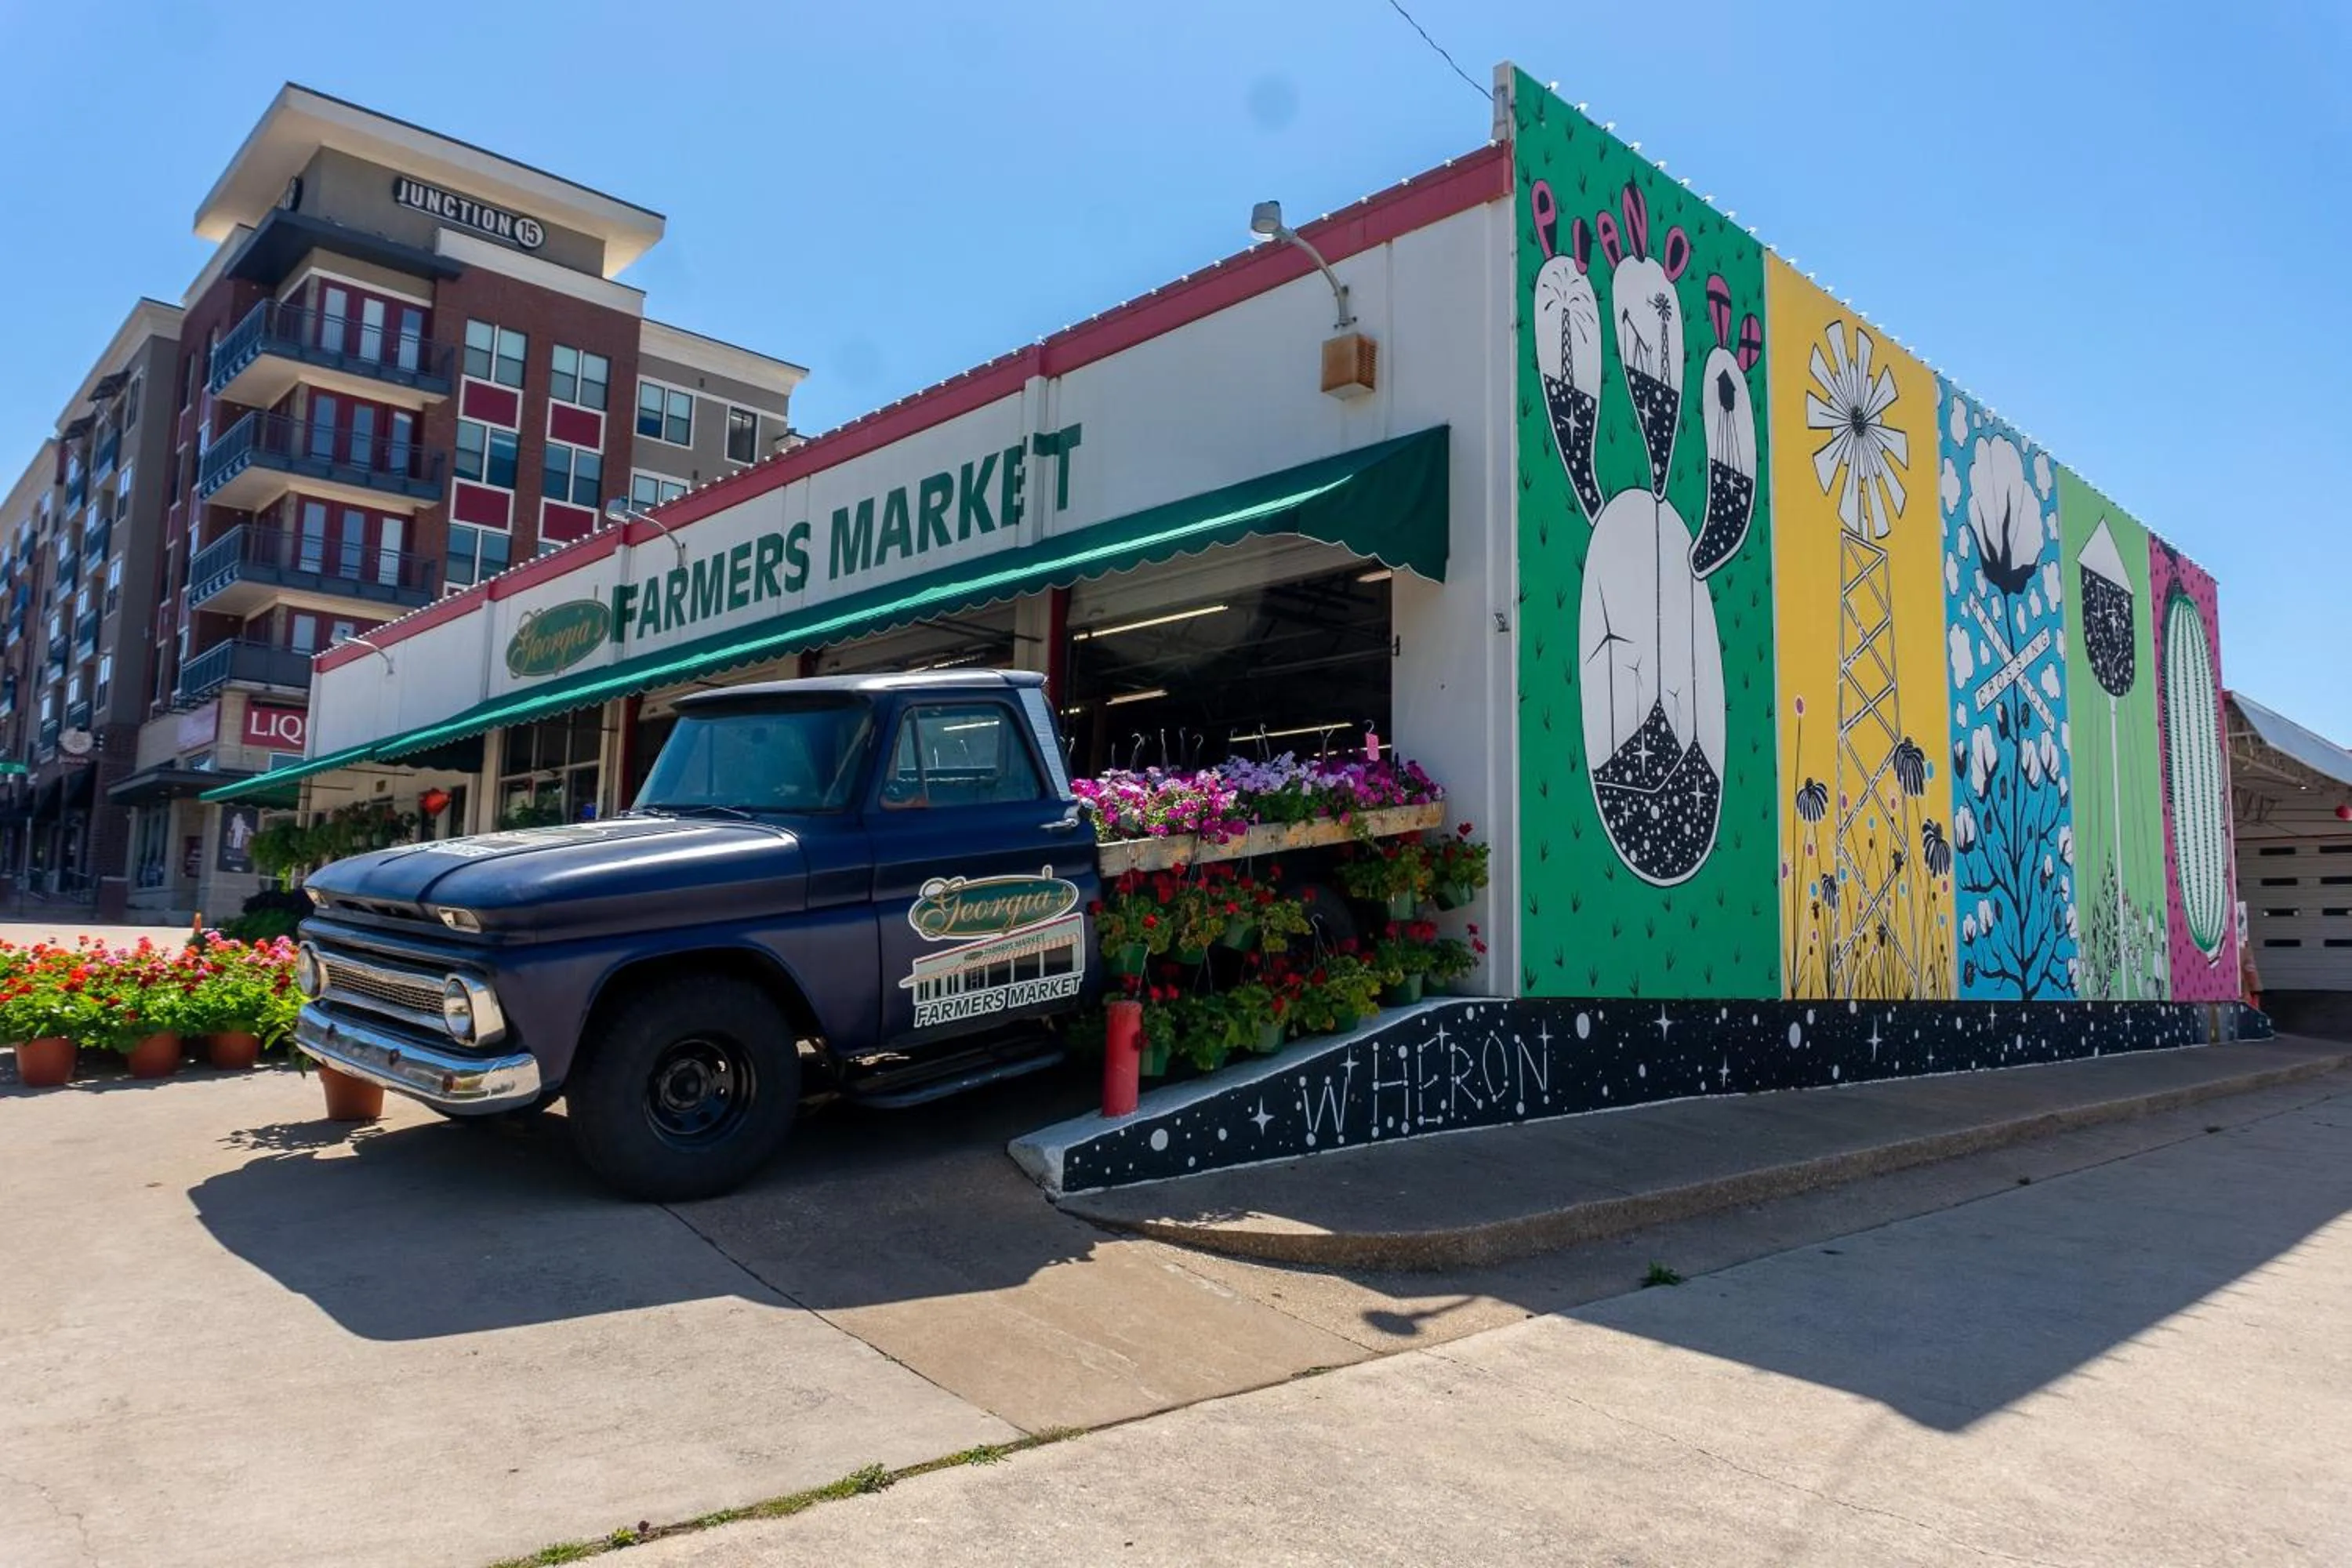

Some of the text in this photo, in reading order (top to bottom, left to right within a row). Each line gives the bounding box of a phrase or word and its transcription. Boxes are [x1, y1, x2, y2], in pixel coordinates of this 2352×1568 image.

[398, 179, 539, 245] JUNCTION 15
[1530, 178, 1690, 284] PLANO
[609, 423, 1082, 644] FARMERS MARKET
[1978, 631, 2049, 707] CROSSING
[250, 710, 306, 745] LIQ
[914, 975, 1082, 1027] FARMERS MARKET
